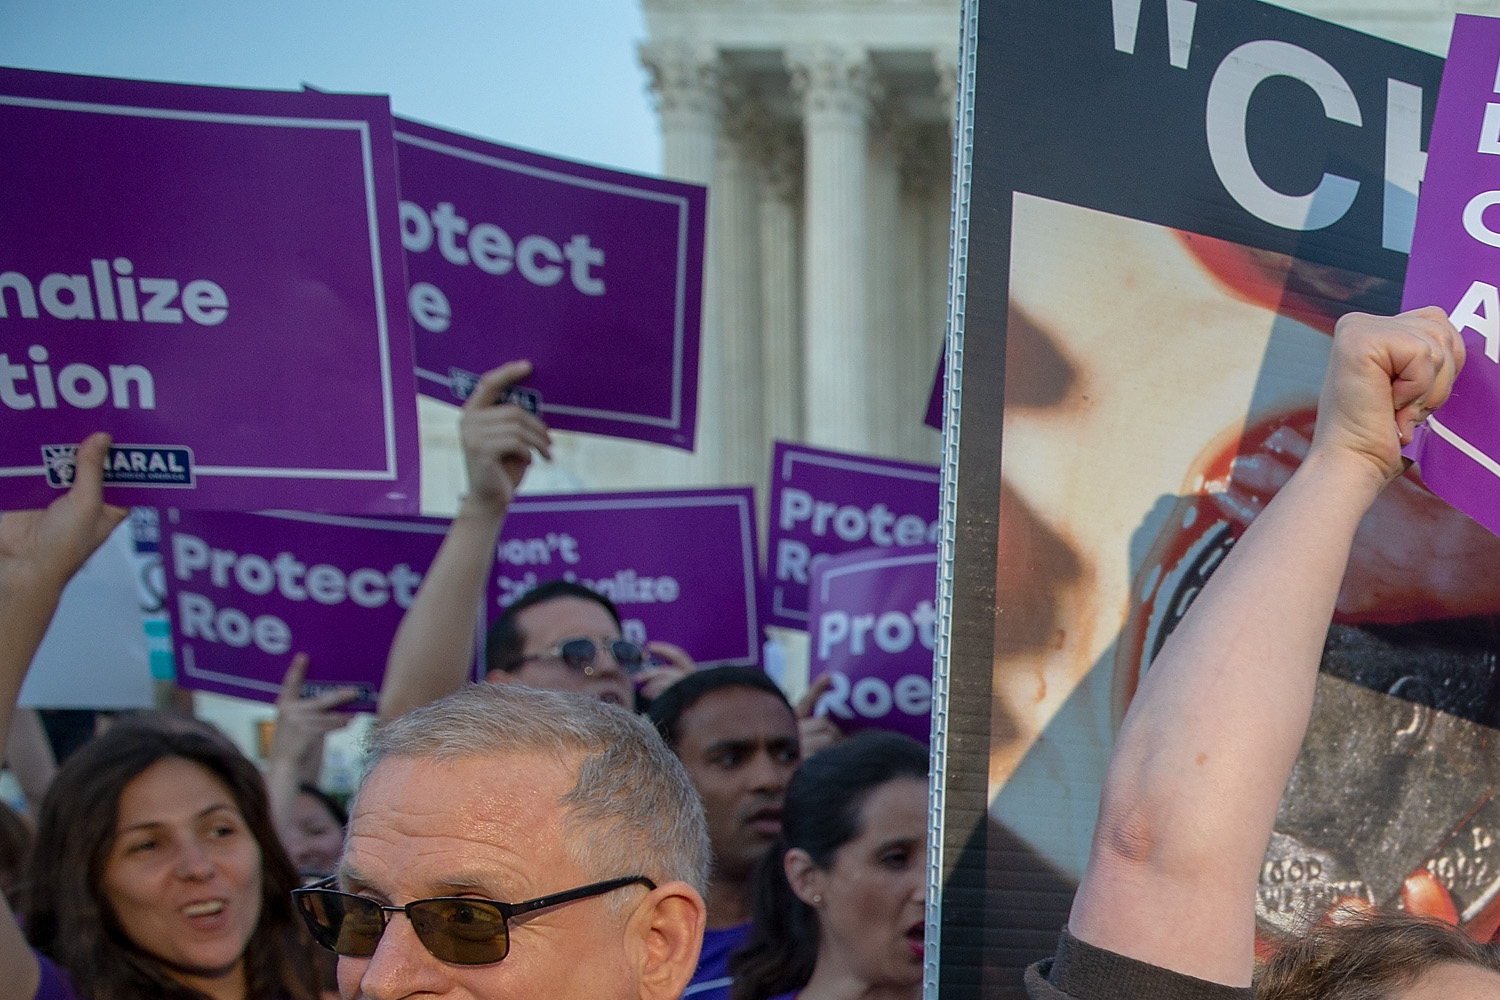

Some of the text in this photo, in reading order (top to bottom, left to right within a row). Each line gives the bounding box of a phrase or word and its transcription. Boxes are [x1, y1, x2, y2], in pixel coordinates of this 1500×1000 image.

[171, 530, 424, 609] Protect
[497, 531, 580, 567] on't
[177, 589, 293, 656] Roe
